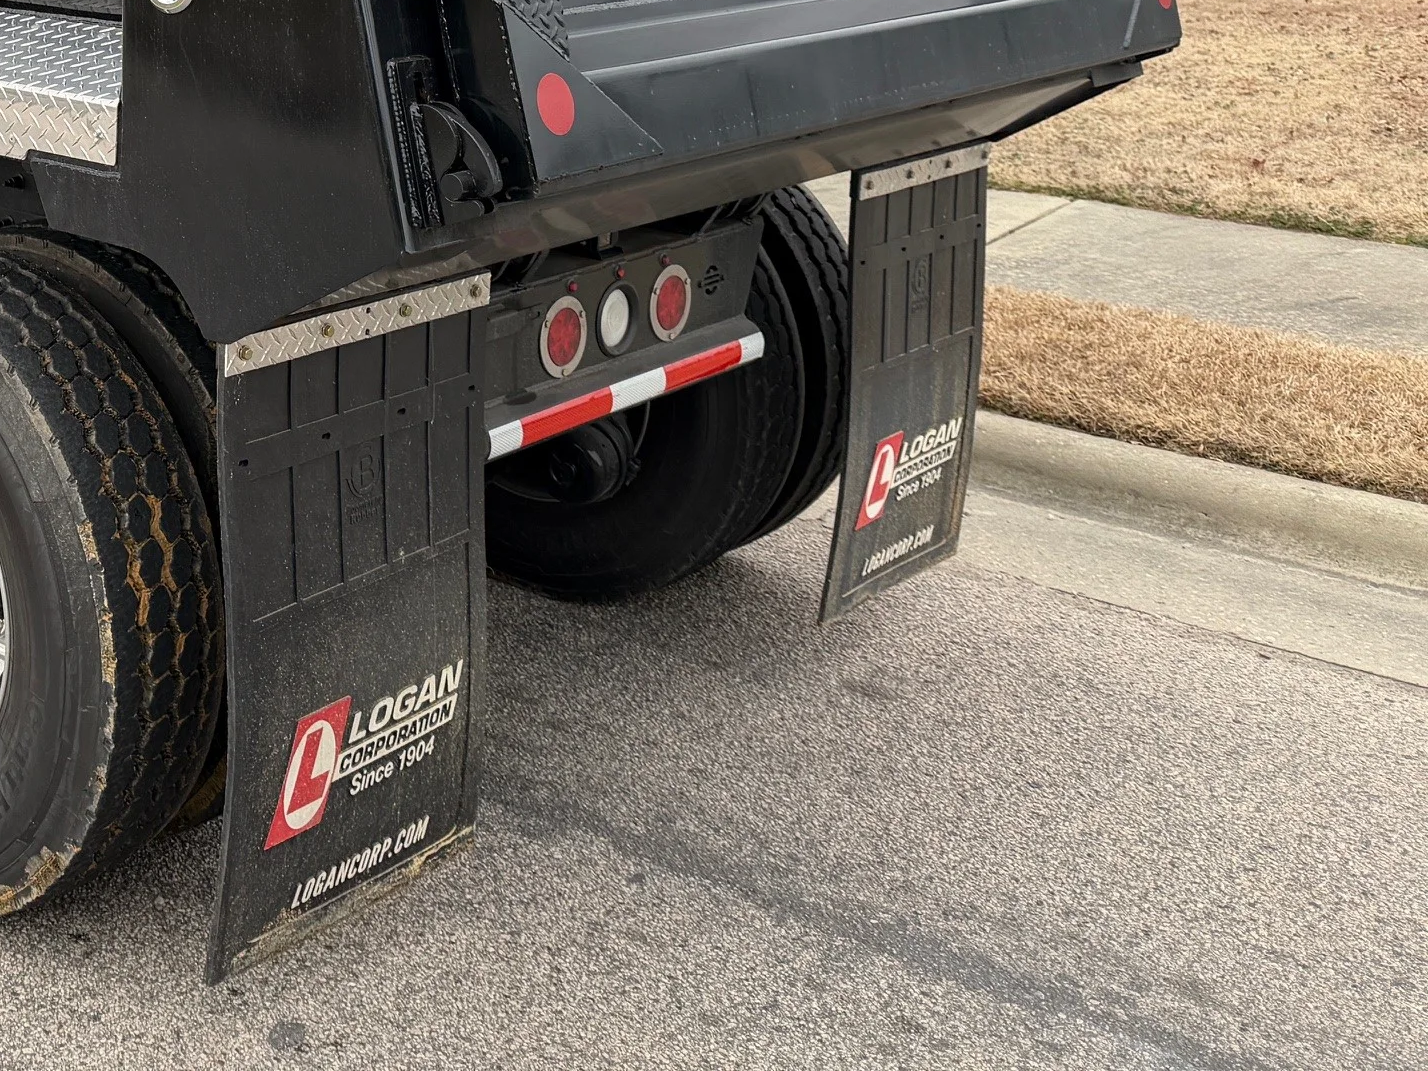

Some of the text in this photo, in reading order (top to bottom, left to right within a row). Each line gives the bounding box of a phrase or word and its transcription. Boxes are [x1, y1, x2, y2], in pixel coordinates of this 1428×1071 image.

[894, 444, 954, 484] CORPORATION
[899, 417, 963, 464] LOGAN
[895, 467, 942, 502] Since 1904
[861, 525, 934, 577] LOGANCORP.COM
[349, 659, 464, 745] LOGAN
[339, 703, 452, 774] CORPORATION
[349, 735, 435, 796] Since 1904
[290, 815, 430, 910] LOGANCORP.COM
